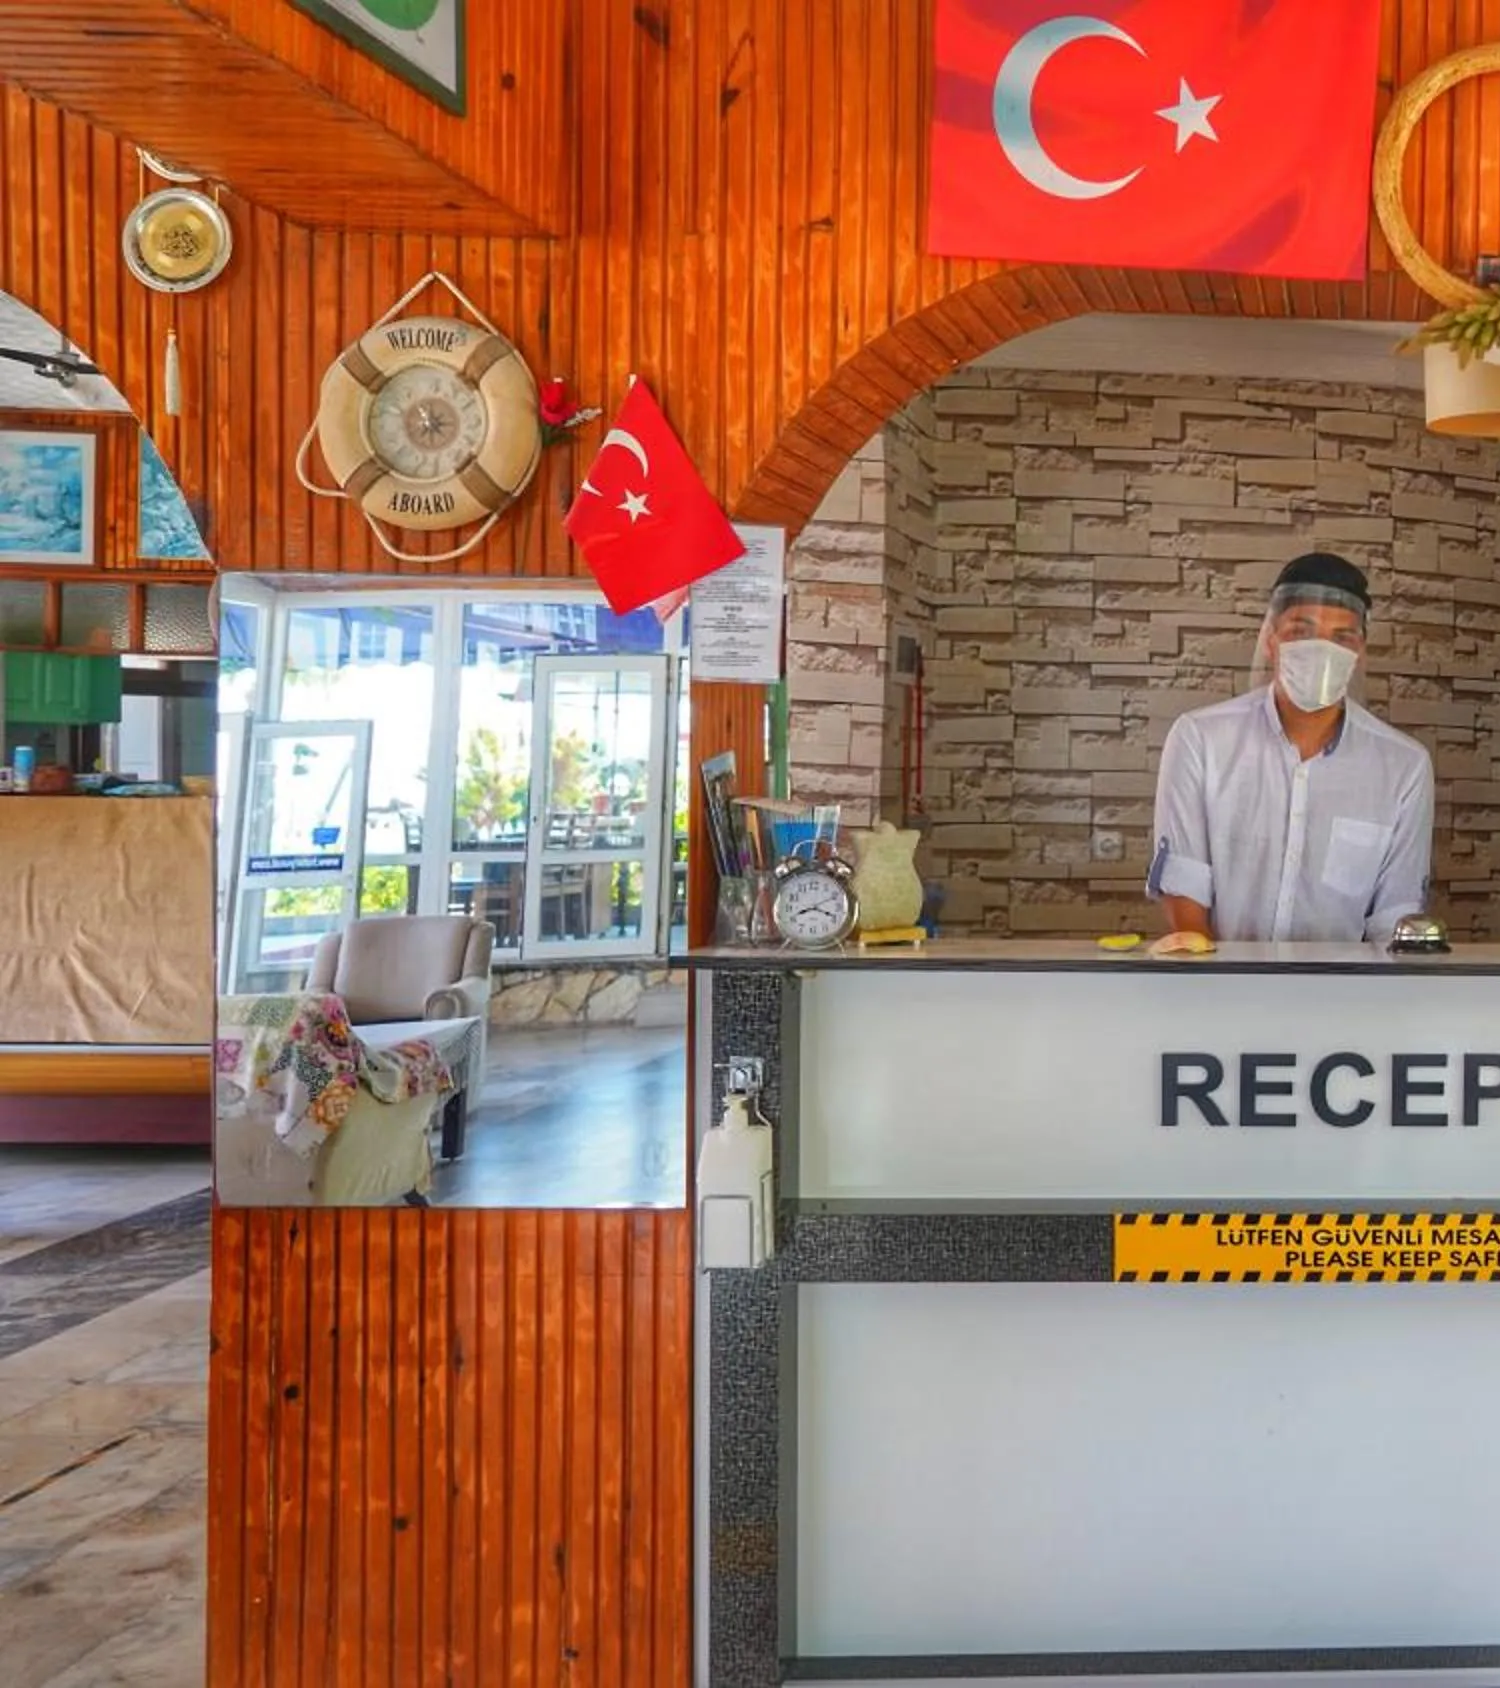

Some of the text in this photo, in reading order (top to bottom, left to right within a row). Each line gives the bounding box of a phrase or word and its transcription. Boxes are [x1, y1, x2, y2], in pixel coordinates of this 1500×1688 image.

[386, 327, 454, 352] WELCOME
[388, 491, 455, 516] ABOARD
[1215, 1229, 1303, 1246] LÜTFEN
[1285, 1250, 1373, 1268] PLEASE
[1383, 1250, 1441, 1268] KEEP
